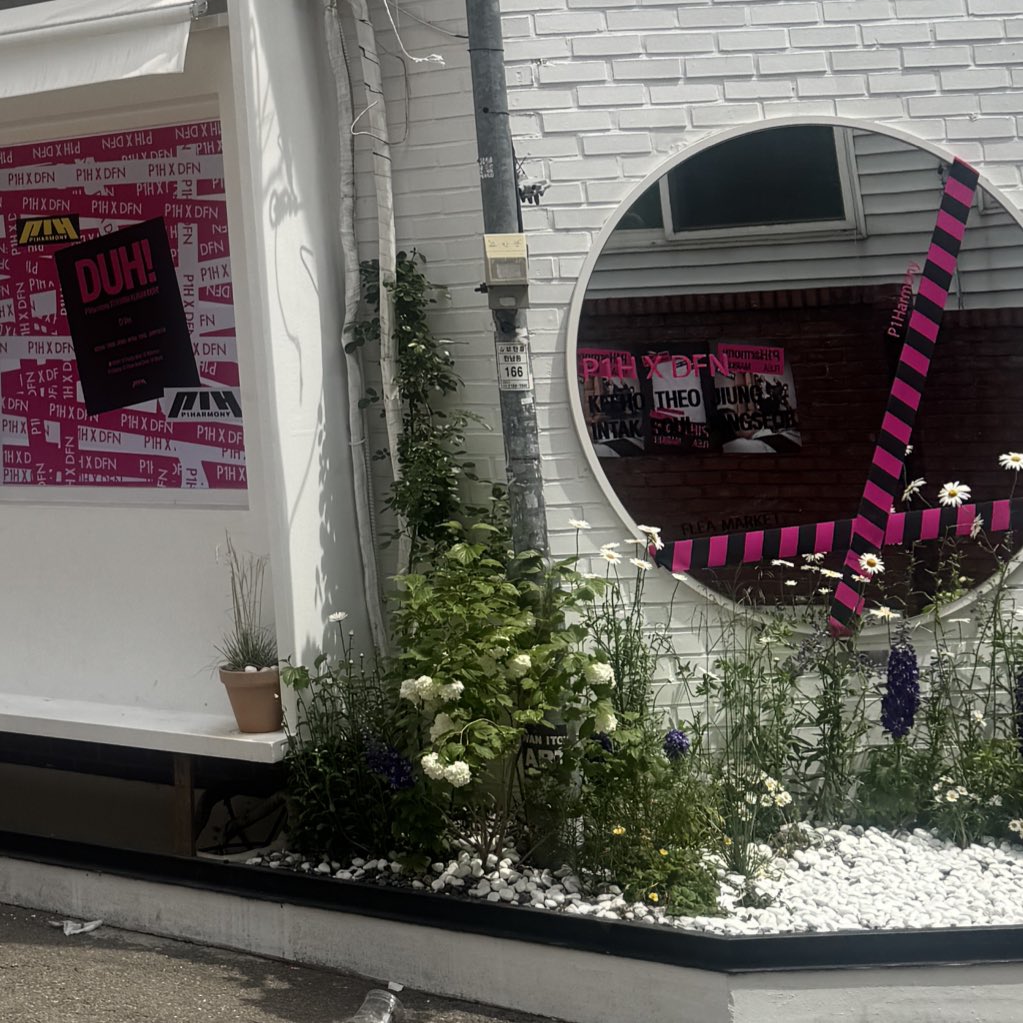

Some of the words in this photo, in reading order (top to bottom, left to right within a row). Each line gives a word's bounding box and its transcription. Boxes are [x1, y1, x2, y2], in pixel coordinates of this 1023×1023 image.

[76, 168, 93, 182] P1H
[104, 166, 126, 179] DFN
[148, 163, 166, 177] P1H
[177, 162, 201, 175] DFN
[8, 172, 24, 186] P1H
[34, 171, 56, 184] DFN
[22, 196, 39, 210] P1H
[49, 198, 70, 212] DFN
[91, 199, 109, 214] P1H
[119, 202, 142, 215] DFN
[164, 203, 183, 218] P1H
[194, 205, 219, 219] DFN
[200, 240, 224, 256] DFN
[75, 238, 157, 304] DUH!
[28, 341, 44, 355] P1H
[202, 343, 227, 356] DFN
[505, 365, 523, 378] 166
[582, 355, 638, 382] P1H
[672, 353, 730, 379] DFN
[655, 389, 701, 409] THEO
[49, 403, 66, 418] P1H
[121, 413, 139, 429] P1H
[150, 419, 173, 434] DFN
[592, 420, 643, 441] INTAK
[196, 425, 216, 441] P1H
[216, 465, 236, 482] P1H
